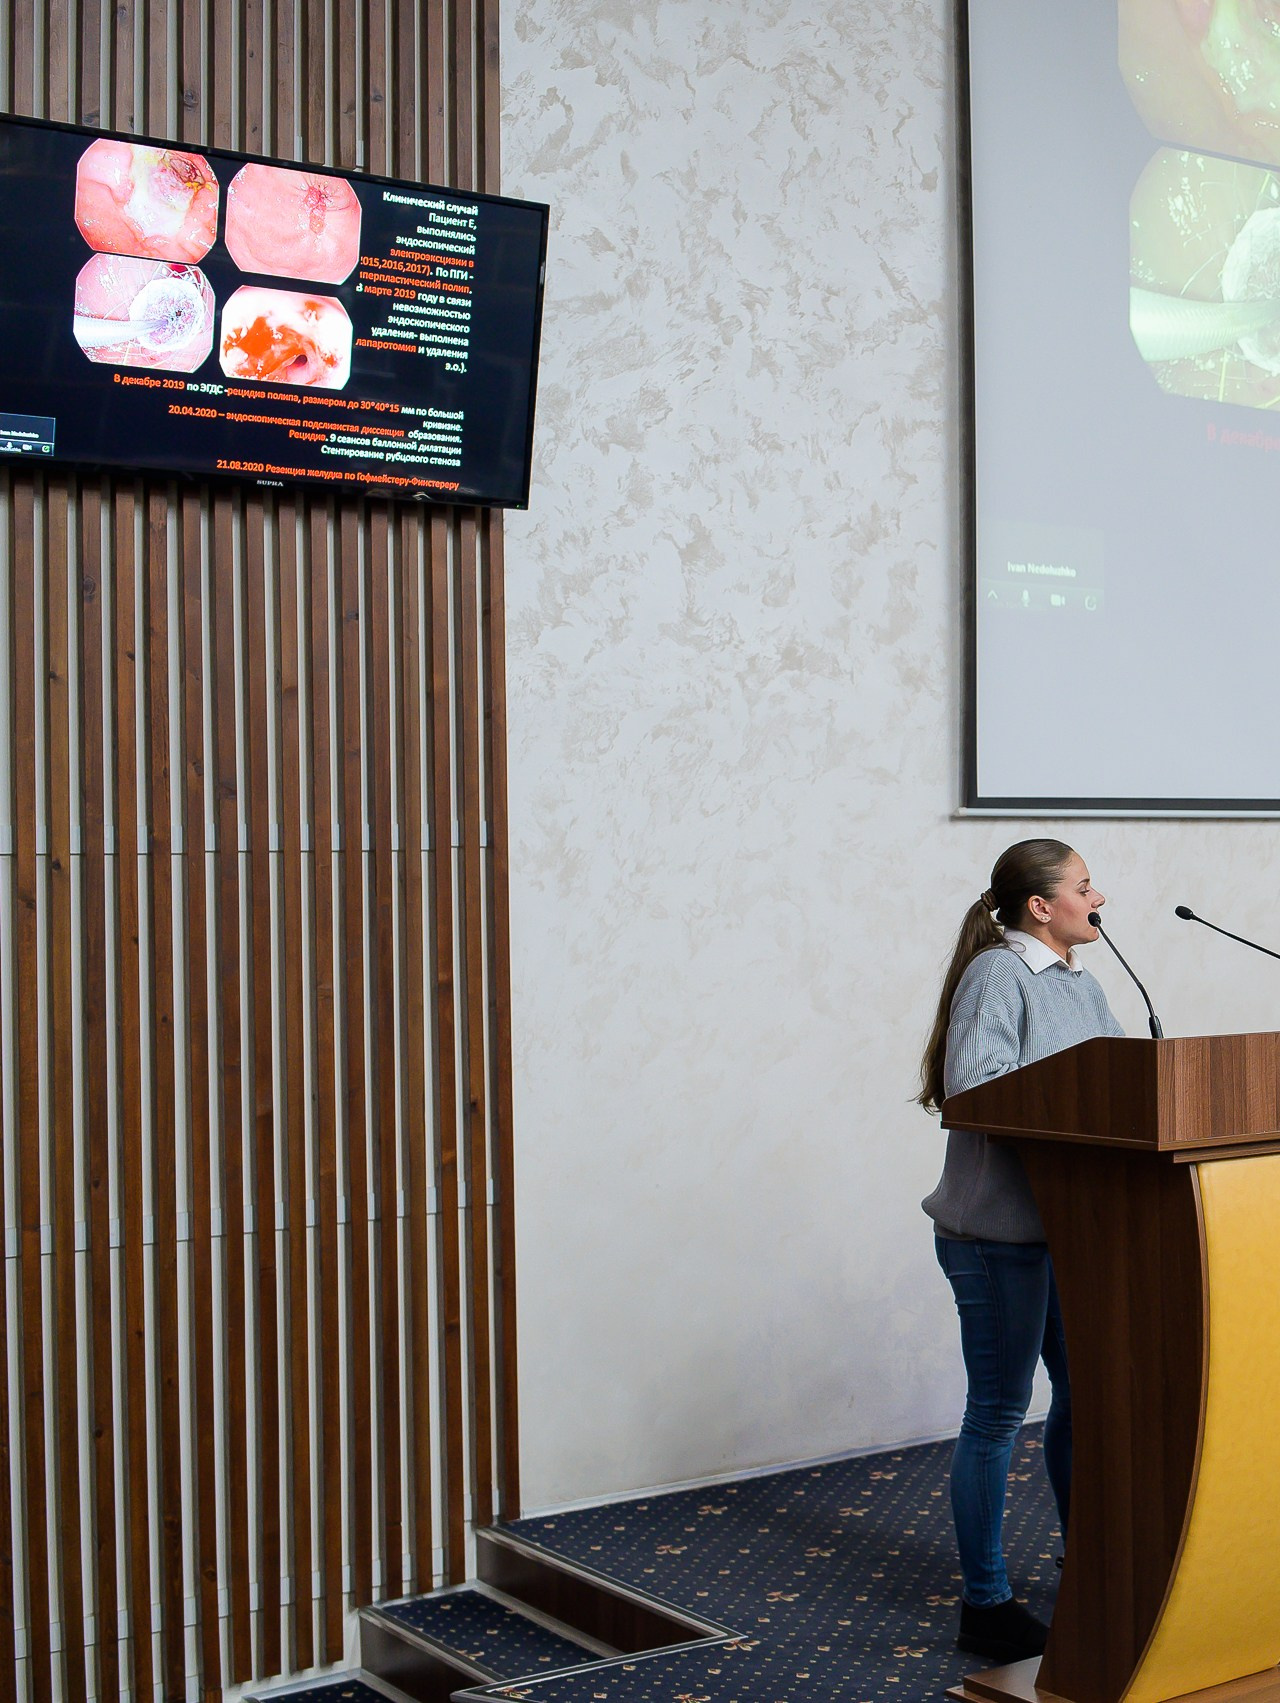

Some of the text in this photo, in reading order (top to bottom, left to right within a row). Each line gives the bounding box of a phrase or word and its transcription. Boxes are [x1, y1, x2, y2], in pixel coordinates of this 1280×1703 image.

[383, 191, 478, 216] Клинический случай
[429, 212, 467, 228] Пациент
[417, 226, 476, 242] выполнялись
[396, 236, 476, 254] эндоскопический
[390, 248, 468, 266] электроэксцизии
[436, 267, 448, 278] По
[450, 269, 468, 280] ПГИ
[364, 286, 392, 297] марте
[394, 288, 416, 299] 2019
[418, 293, 438, 304] году
[440, 296, 444, 304] в
[446, 297, 472, 307] связи
[442, 283, 472, 294] полип.
[393, 303, 470, 320] невозможностью
[388, 316, 470, 334] эндоскопического
[356, 338, 468, 360] лапаротомия и удаления
[420, 334, 468, 346] выполнена
[114, 374, 120, 382] В
[122, 376, 161, 388] декабре
[163, 379, 184, 390] 2019
[186, 384, 199, 392] по
[200, 384, 224, 395] ЭГДС
[268, 392, 301, 404] полипа,
[302, 395, 346, 408] размером
[401, 406, 415, 414] мм
[416, 408, 426, 416] по
[428, 406, 464, 420] большой
[168, 404, 216, 418] 20.04.2020
[226, 412, 300, 427] эндоскопическая
[302, 420, 359, 432] подслизистая
[361, 426, 404, 438] диссекция
[408, 430, 462, 444] образования.
[423, 420, 463, 432] кривизне.
[330, 434, 336, 442] 9
[337, 436, 370, 446] сеансов
[372, 436, 417, 450] баллонной
[418, 442, 462, 456] дилатации
[321, 445, 460, 466] Стентирование рубцового стеноза
[216, 460, 460, 491] 21.08.2020 Резекция желудка по Гофмейстеру-Финстереру
